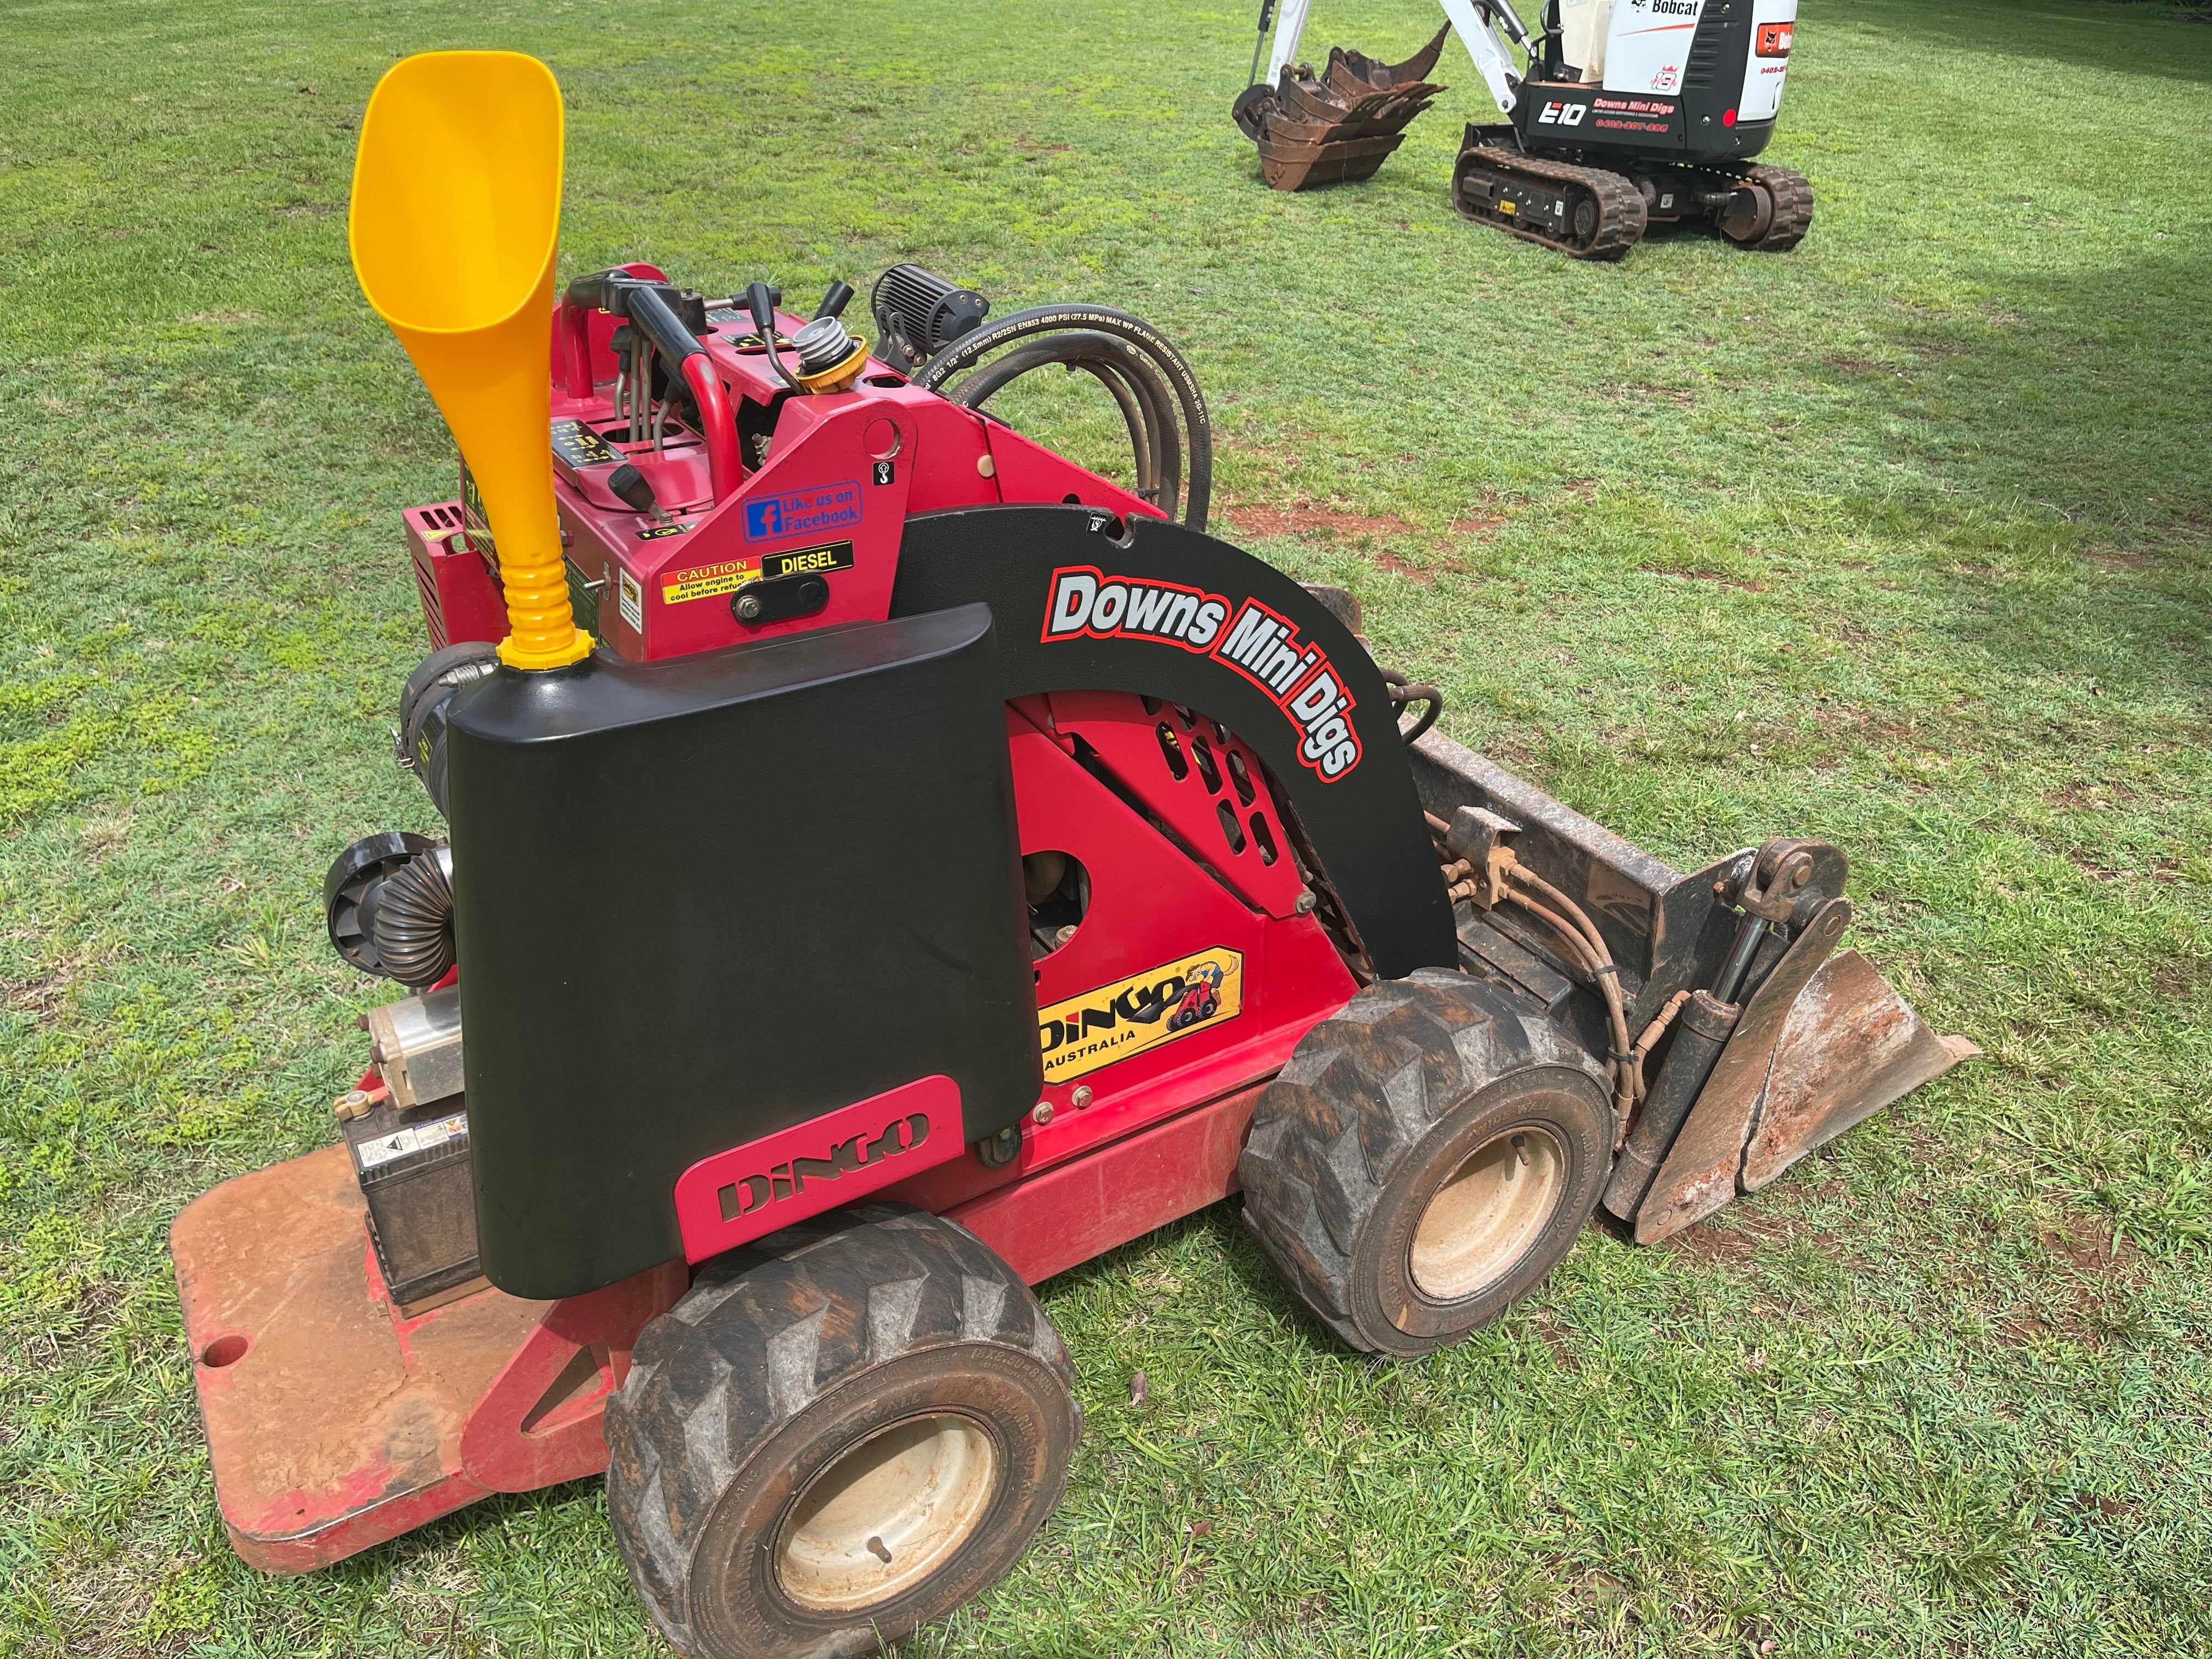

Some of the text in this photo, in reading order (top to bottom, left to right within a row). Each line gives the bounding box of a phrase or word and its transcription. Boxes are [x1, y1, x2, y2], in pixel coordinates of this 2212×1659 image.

[1652, 0, 1697, 15] Bobcat
[1538, 101, 1587, 126] E10
[1593, 97, 1627, 109] Downs
[1628, 100, 1649, 112] Mini
[1650, 103, 1674, 114] Digs
[962, 335, 992, 357] (12.5mm)
[992, 325, 1017, 341] R2/2SN
[1018, 319, 1040, 330] EN853
[1041, 315, 1057, 324] 4000
[1058, 313, 1069, 322] PSI
[1088, 313, 1105, 322] MPa)
[1105, 317, 1121, 326] MAX
[1122, 321, 1133, 330] WP
[1133, 326, 1155, 343] FLAME
[1155, 339, 1184, 371] RESISTANT
[1181, 370, 1198, 399] USMSHA
[816, 494, 833, 506] us
[835, 490, 853, 503] on
[785, 506, 857, 532] Facebook
[676, 560, 747, 582] CAUTION
[781, 551, 837, 573] DIESEL
[670, 591, 689, 601] cool
[691, 586, 718, 597] before
[679, 582, 703, 591] Allow
[706, 576, 733, 588] engine
[1052, 574, 1357, 775] Downs Mini Digs
[1045, 1030, 1136, 1071] AUSTRALIA
